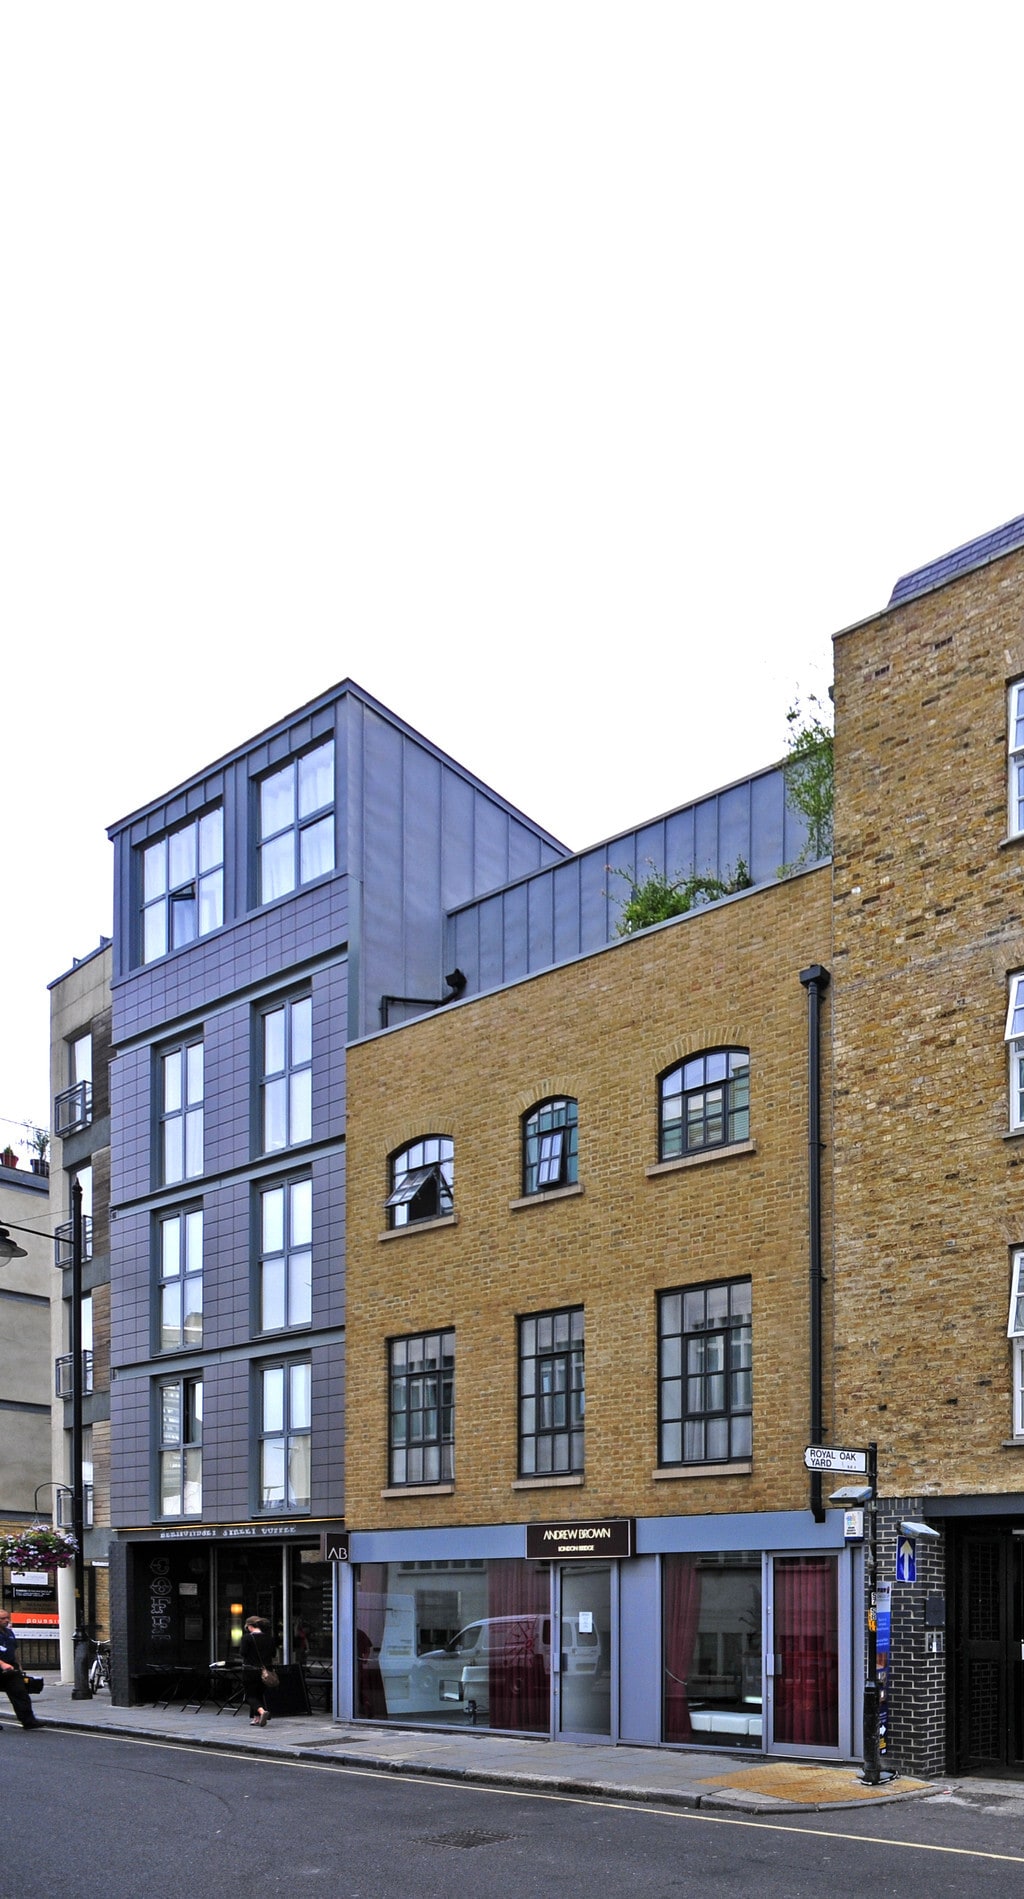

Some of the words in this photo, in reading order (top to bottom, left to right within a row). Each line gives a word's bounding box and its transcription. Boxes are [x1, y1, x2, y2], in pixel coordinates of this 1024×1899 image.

[810, 1449, 836, 1460] ROYAL
[839, 1451, 857, 1461] OAK
[810, 1458, 832, 1467] YARD
[222, 1528, 256, 1536] STREET
[543, 1529, 577, 1540] ANDREW
[578, 1527, 611, 1539] BROWN
[327, 1547, 348, 1560] AB
